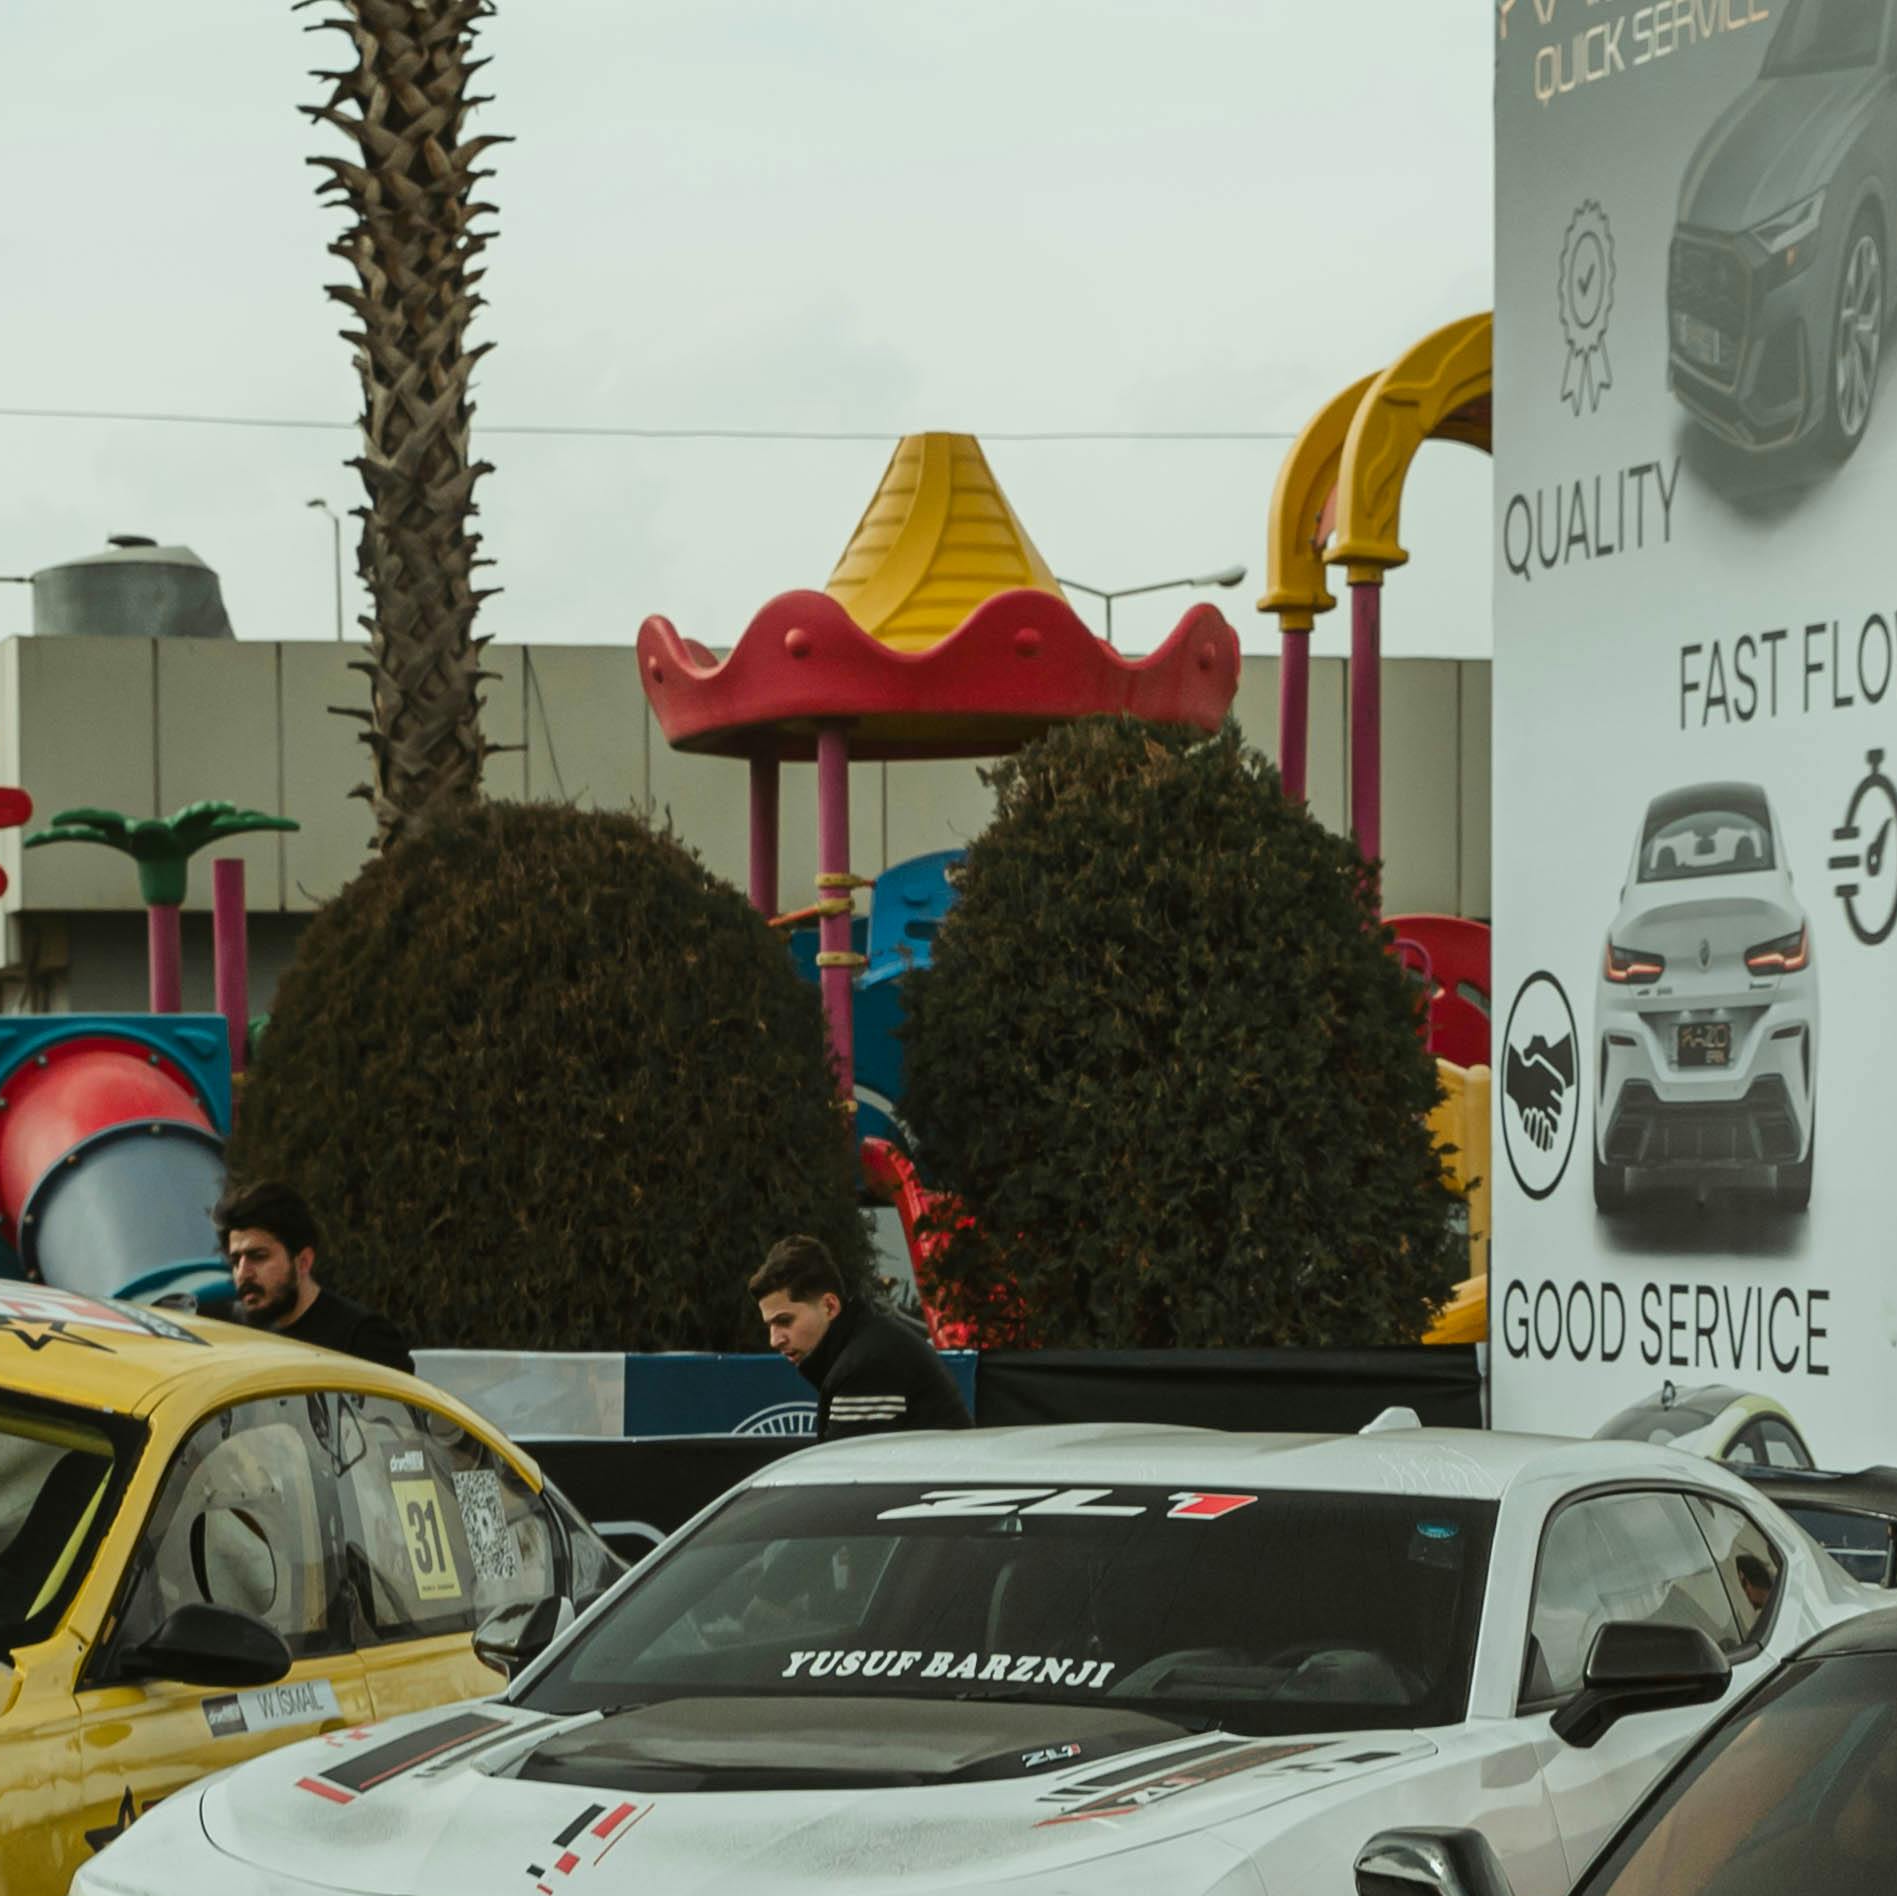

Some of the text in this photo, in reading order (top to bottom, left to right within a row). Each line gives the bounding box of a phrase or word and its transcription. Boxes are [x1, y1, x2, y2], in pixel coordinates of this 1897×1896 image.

[1534, 16, 1625, 106] QUICK
[1504, 456, 1682, 581] QUALITY
[1681, 629, 1788, 730] FAST
[1503, 1279, 1830, 1376] GOOD SERVICE
[407, 1500, 446, 1574] 31
[877, 1489, 1257, 1520] ZL1
[782, 1651, 1114, 1688] YUSUF BARZNJI
